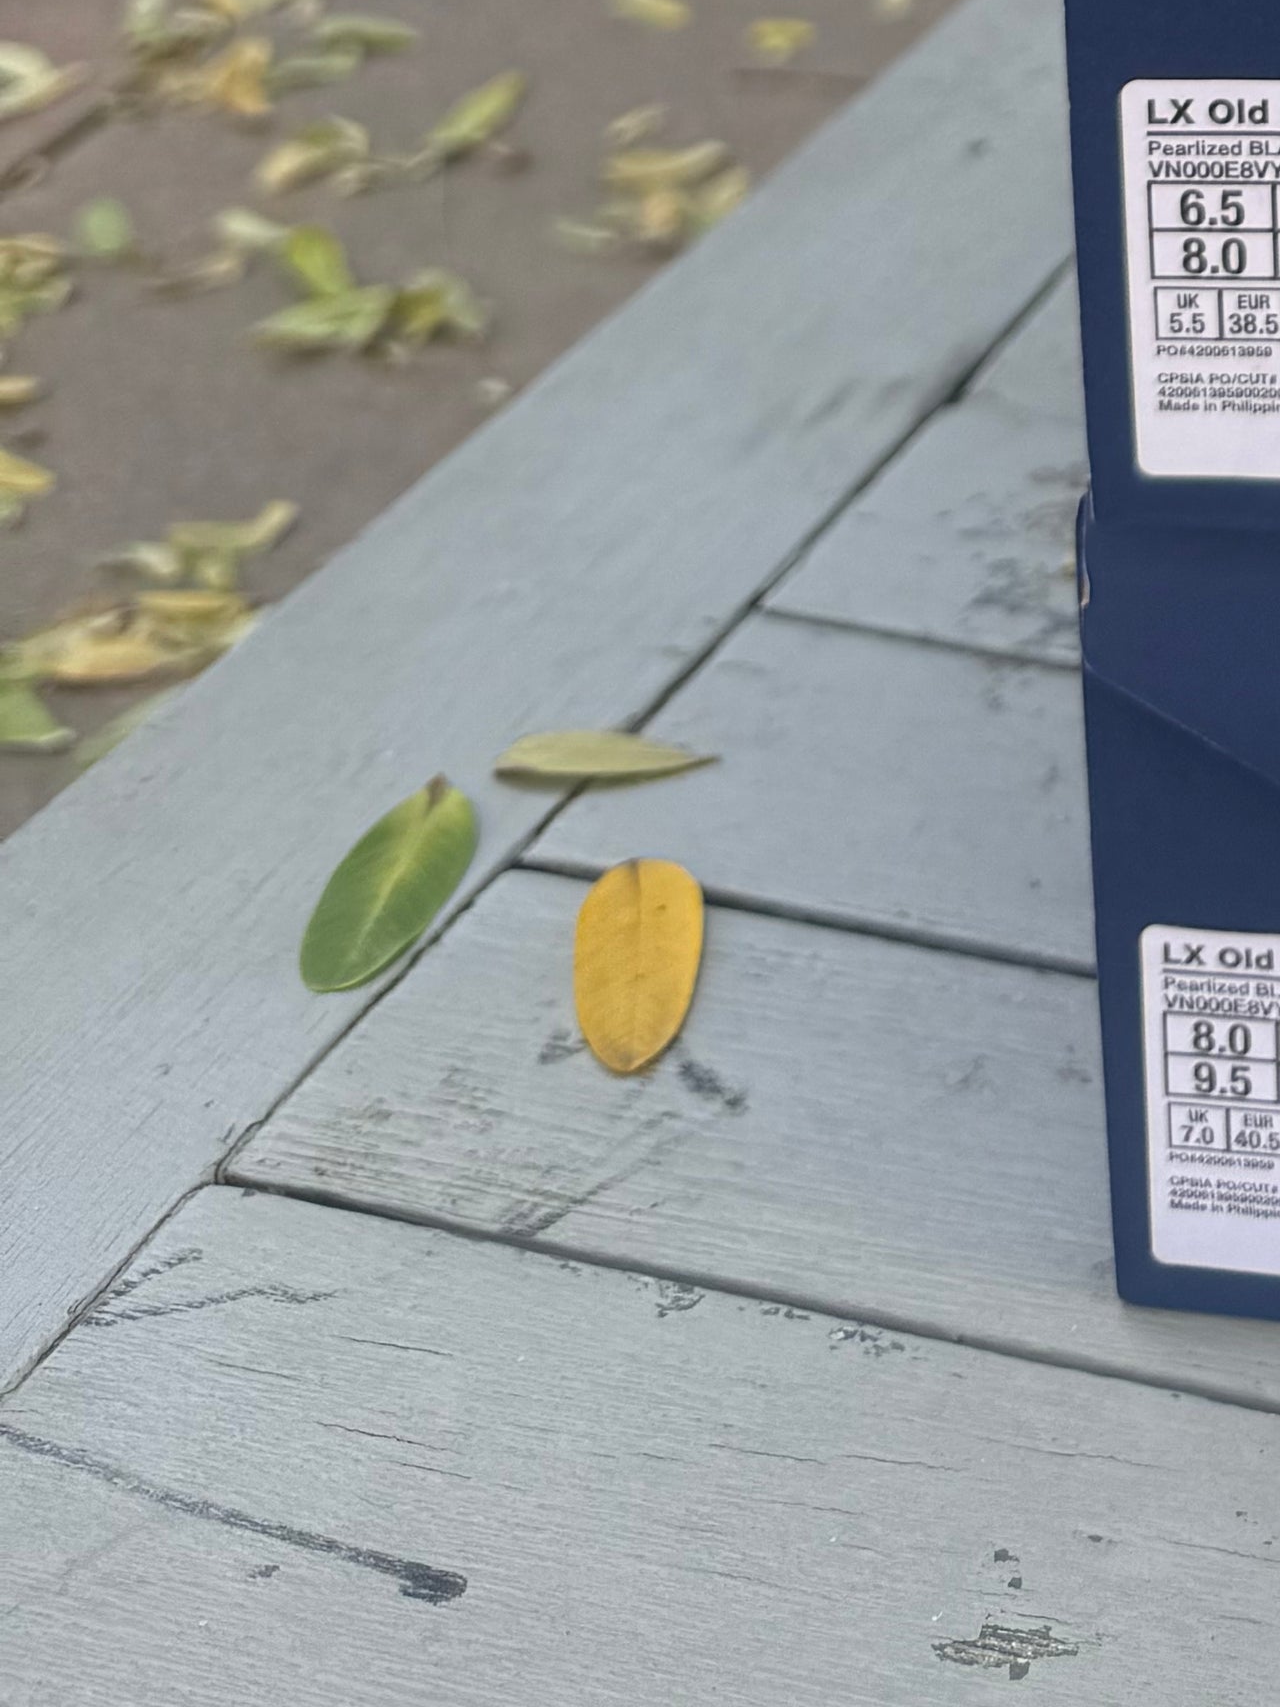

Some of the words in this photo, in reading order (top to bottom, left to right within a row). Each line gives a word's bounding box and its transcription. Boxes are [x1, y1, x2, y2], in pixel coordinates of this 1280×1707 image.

[1147, 99, 1195, 124] LX
[1208, 99, 1269, 124] Old
[1148, 141, 1242, 156] Pearlized
[1180, 189, 1245, 226] 6.5
[1182, 237, 1247, 274] 8.0
[1177, 294, 1199, 309] UK
[1237, 295, 1270, 309] EUR
[1169, 313, 1205, 334] 5.5
[1228, 314, 1279, 335] 38.5
[1158, 372, 1204, 385] CPSIA
[1159, 400, 1199, 411] Made
[1204, 400, 1217, 411] in
[1163, 943, 1205, 966] LX
[1219, 947, 1274, 971] Old
[1164, 977, 1250, 995] Pearlized
[1192, 1020, 1251, 1055] 8.0
[1194, 1062, 1252, 1098] 9.5
[1189, 1108, 1209, 1123] UK
[1243, 1113, 1273, 1128] EUR
[1181, 1125, 1214, 1145] 7.0
[1234, 1130, 1280, 1150] 40.5
[1211, 1202, 1223, 1212] in
